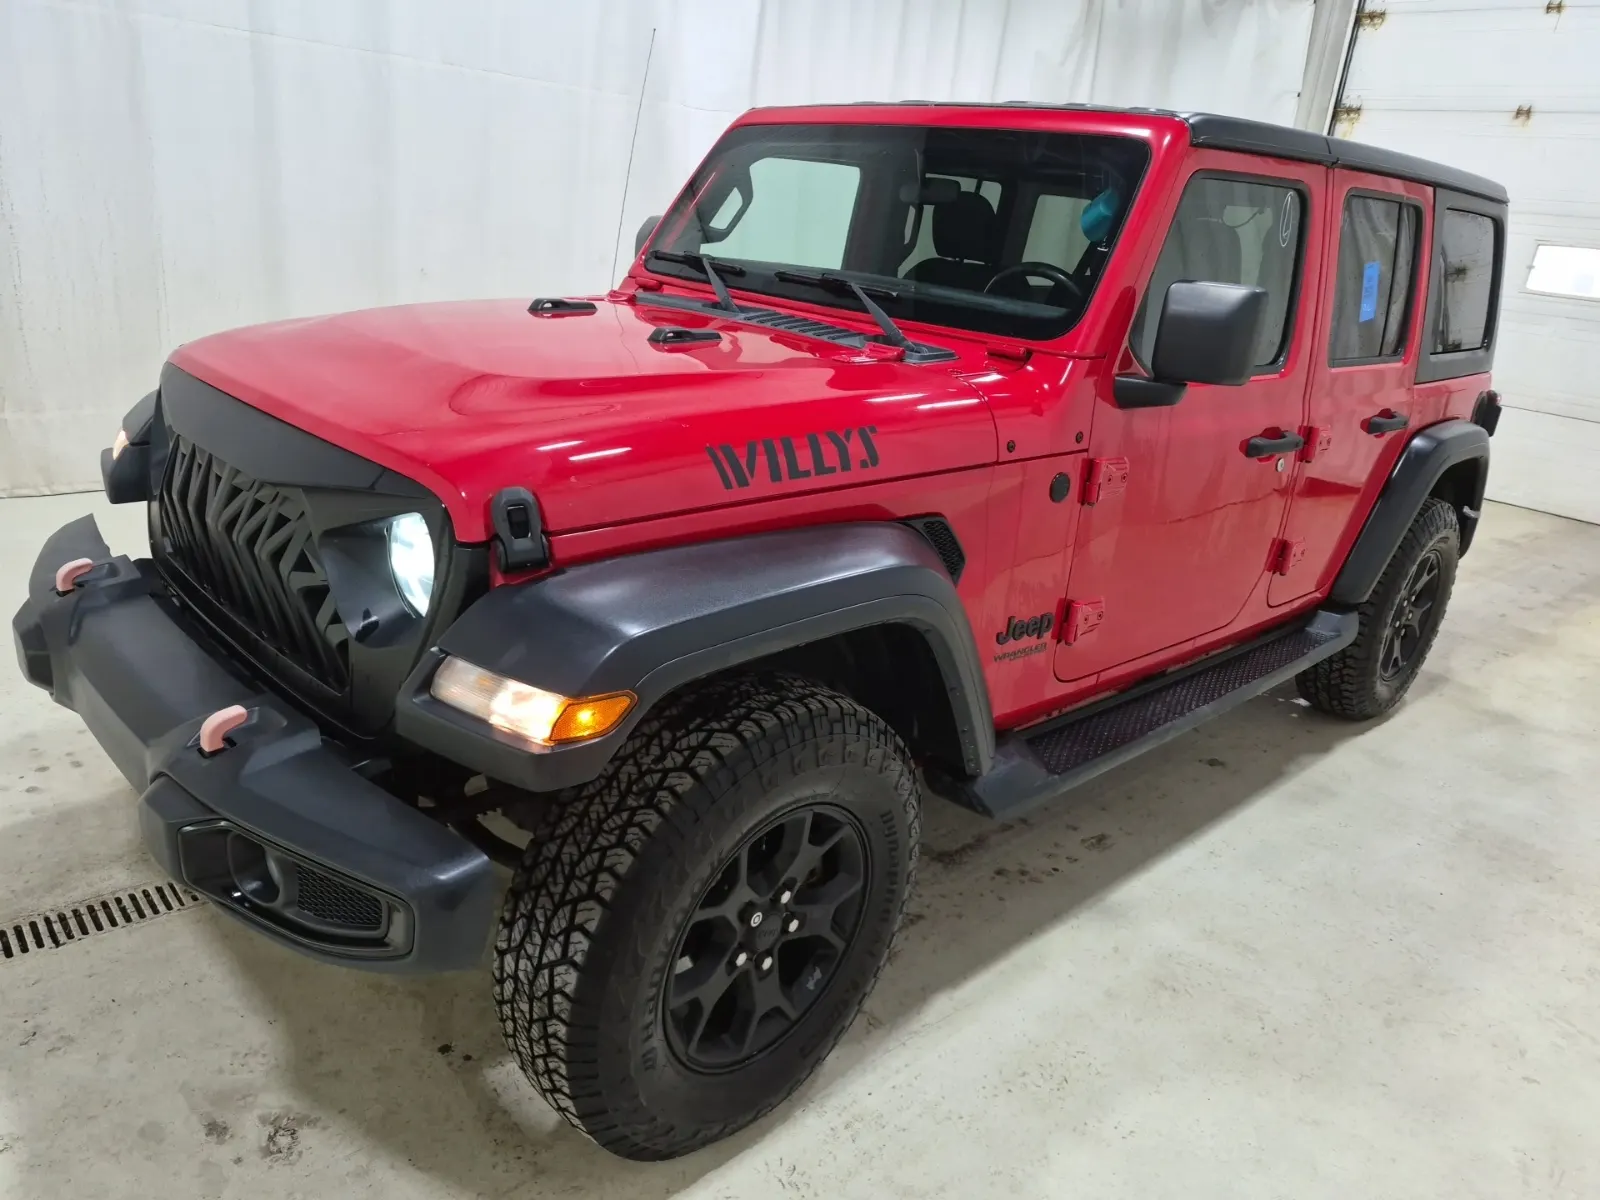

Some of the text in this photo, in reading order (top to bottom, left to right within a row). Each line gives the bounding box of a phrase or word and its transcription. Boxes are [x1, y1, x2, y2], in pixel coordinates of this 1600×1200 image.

[705, 425, 879, 490] WILLYS
[996, 612, 1053, 645] Jeep
[993, 642, 1047, 662] WRANGLER
